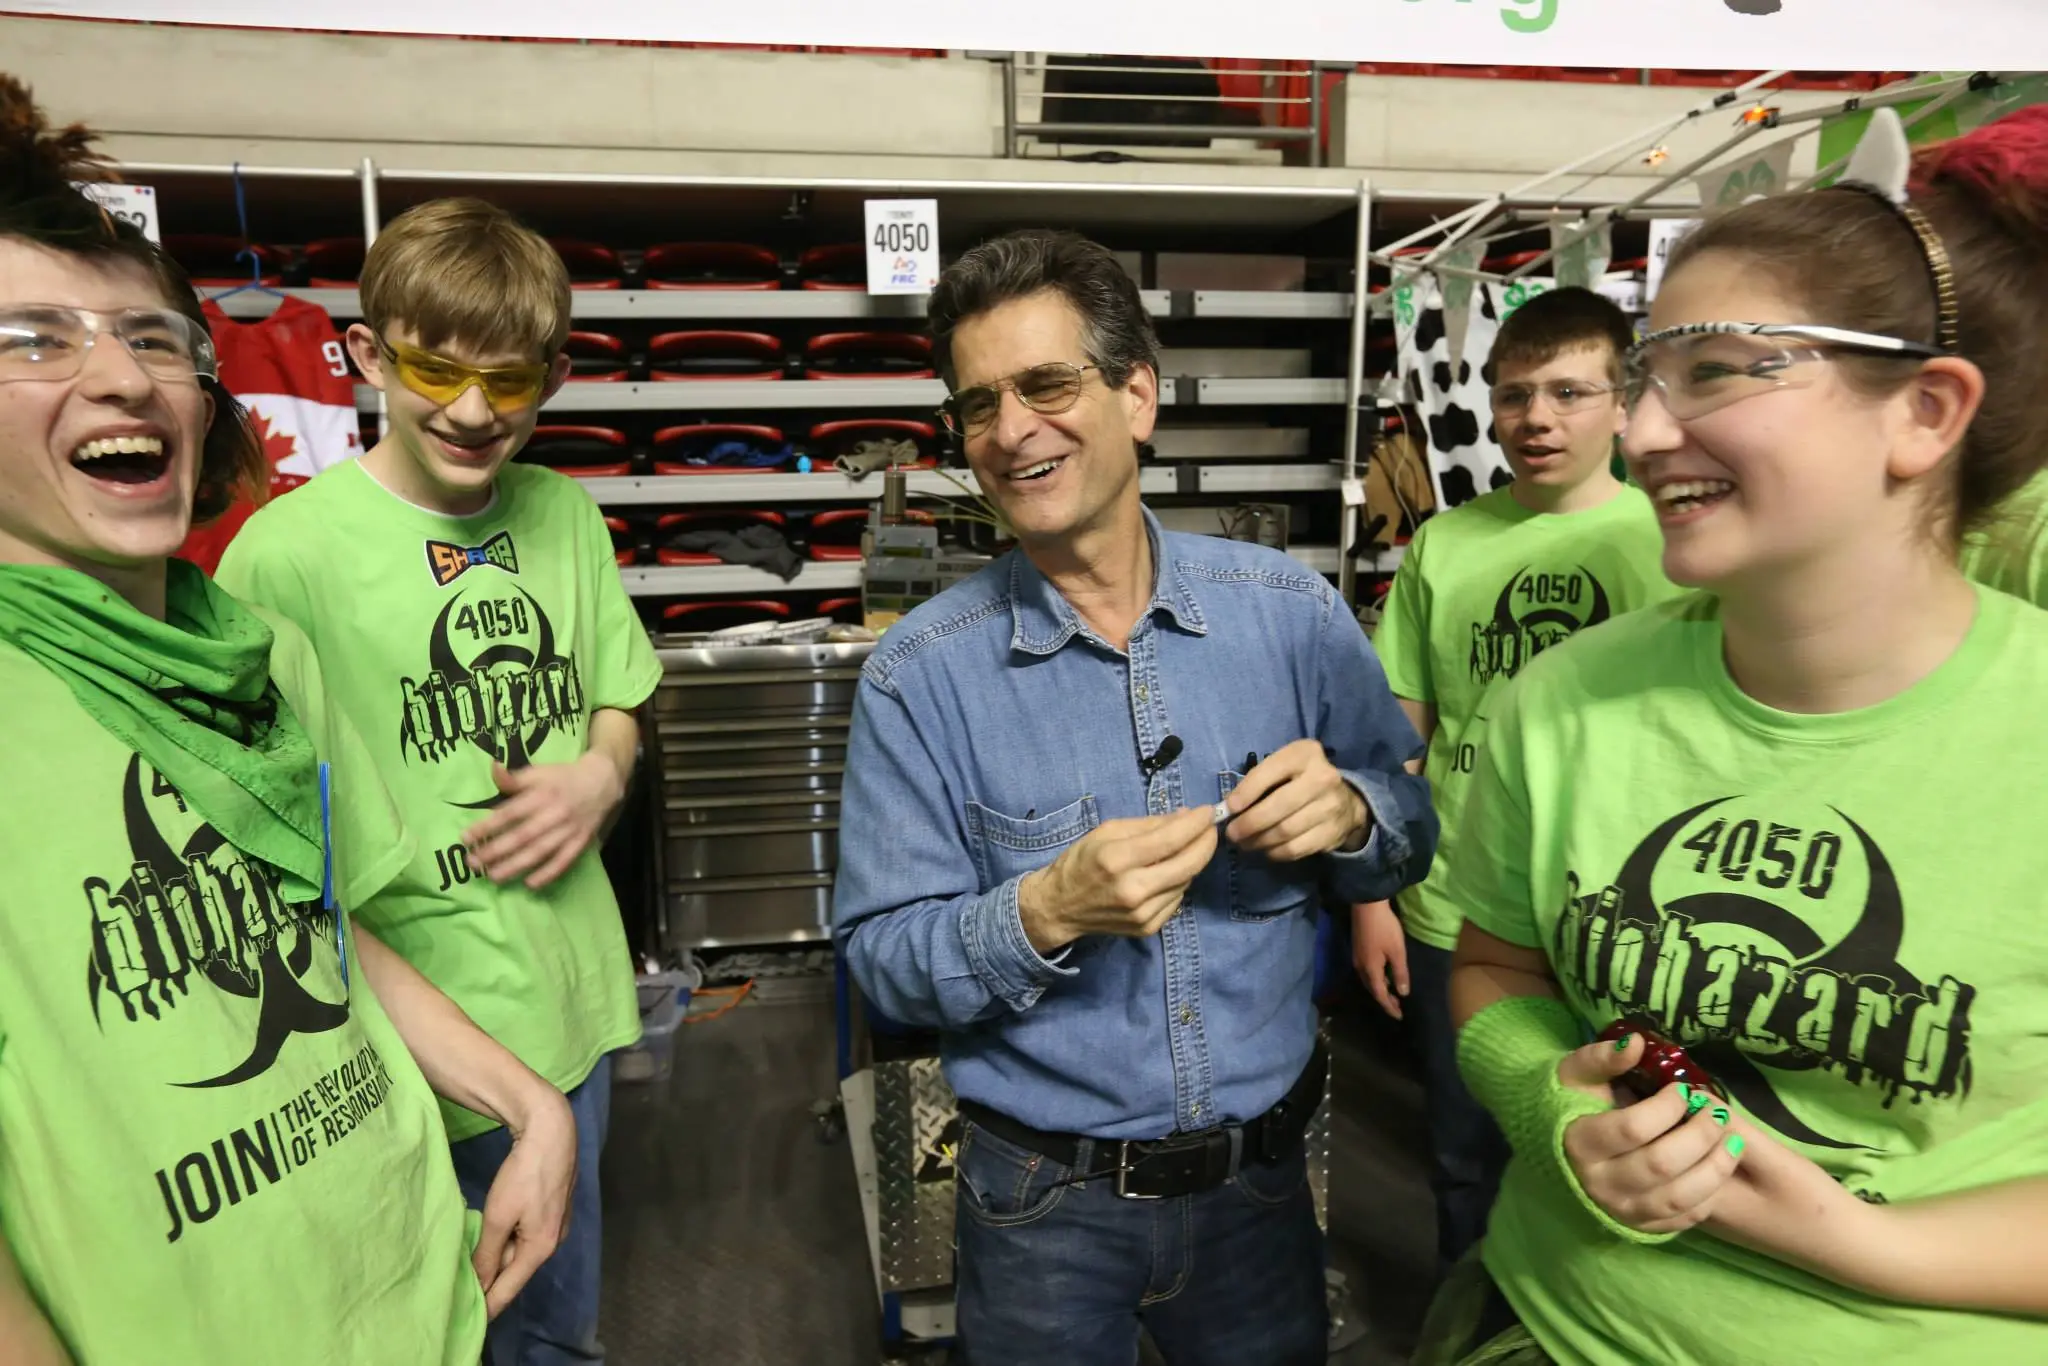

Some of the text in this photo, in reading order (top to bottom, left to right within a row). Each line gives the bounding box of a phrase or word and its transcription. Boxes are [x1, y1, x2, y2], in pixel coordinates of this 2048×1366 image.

[873, 223, 930, 253] 4050
[454, 597, 529, 640] 4050
[1517, 573, 1583, 605] 4050
[1470, 621, 1570, 685] bioha
[434, 843, 488, 892] JO
[1682, 816, 1841, 899] 4050
[84, 850, 332, 1020] biohaz
[154, 1040, 380, 1244] JOIN THE REVOLUTI
[291, 1062, 395, 1167] OF RESONSIY
